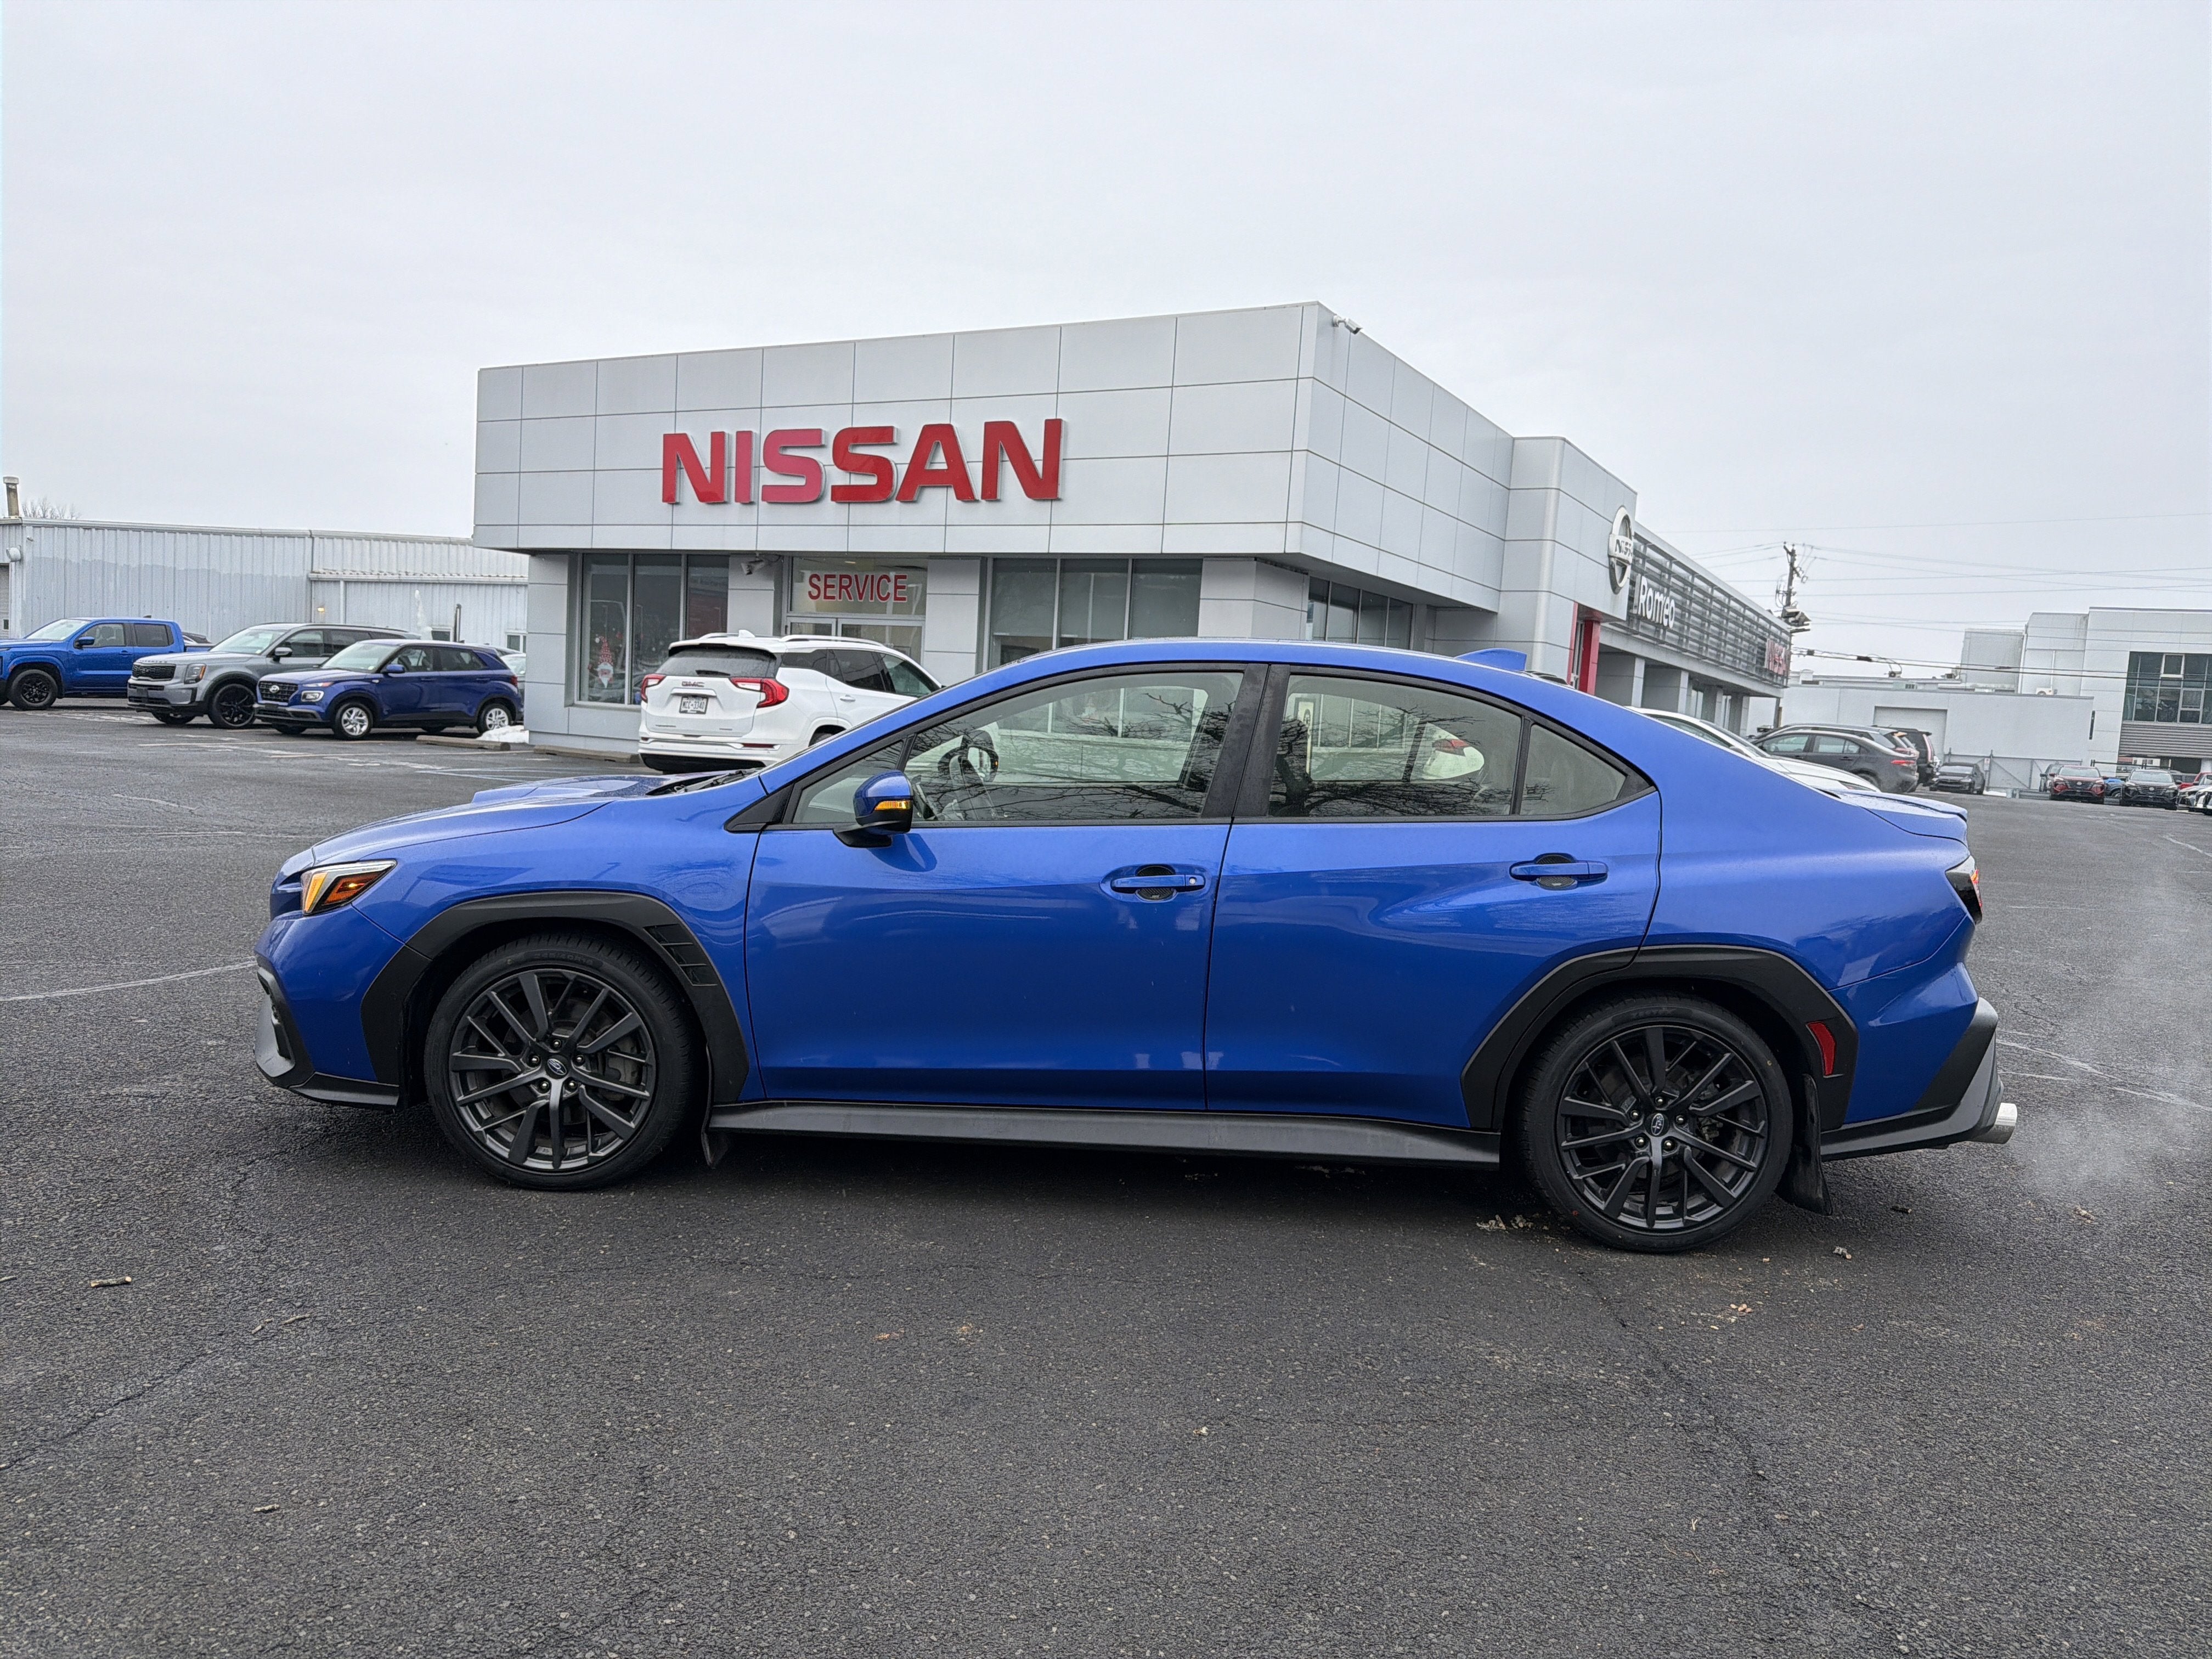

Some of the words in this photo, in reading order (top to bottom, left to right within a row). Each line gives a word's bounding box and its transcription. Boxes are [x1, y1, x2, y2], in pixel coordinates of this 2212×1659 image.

[662, 419, 1063, 504] NISSAN
[808, 573, 909, 603] SERVICE
[1638, 575, 1675, 629] Romeo
